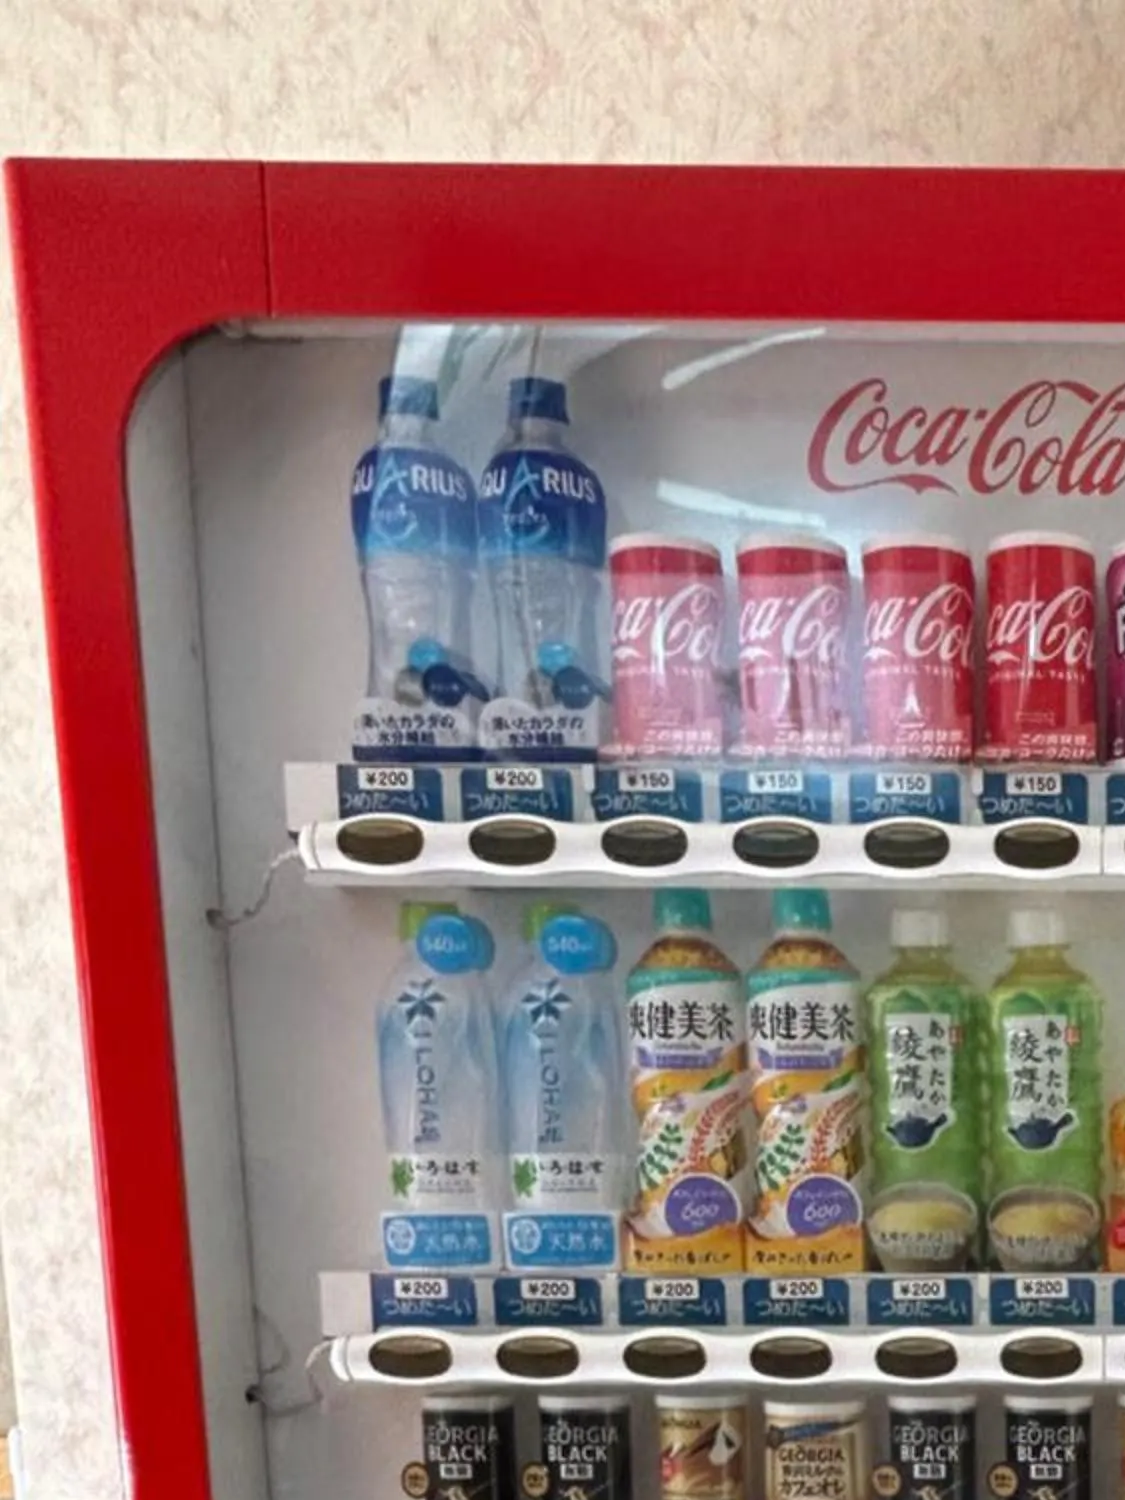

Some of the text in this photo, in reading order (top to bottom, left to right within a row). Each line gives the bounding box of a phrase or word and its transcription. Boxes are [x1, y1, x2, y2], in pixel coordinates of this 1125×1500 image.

[681, 1202, 720, 1220] 600
[803, 1203, 842, 1222] 600
[428, 1445, 487, 1462] BLACK
[547, 1445, 608, 1462] BLACK
[900, 1445, 959, 1462] BLACK
[1017, 1445, 1076, 1462] BLACK
